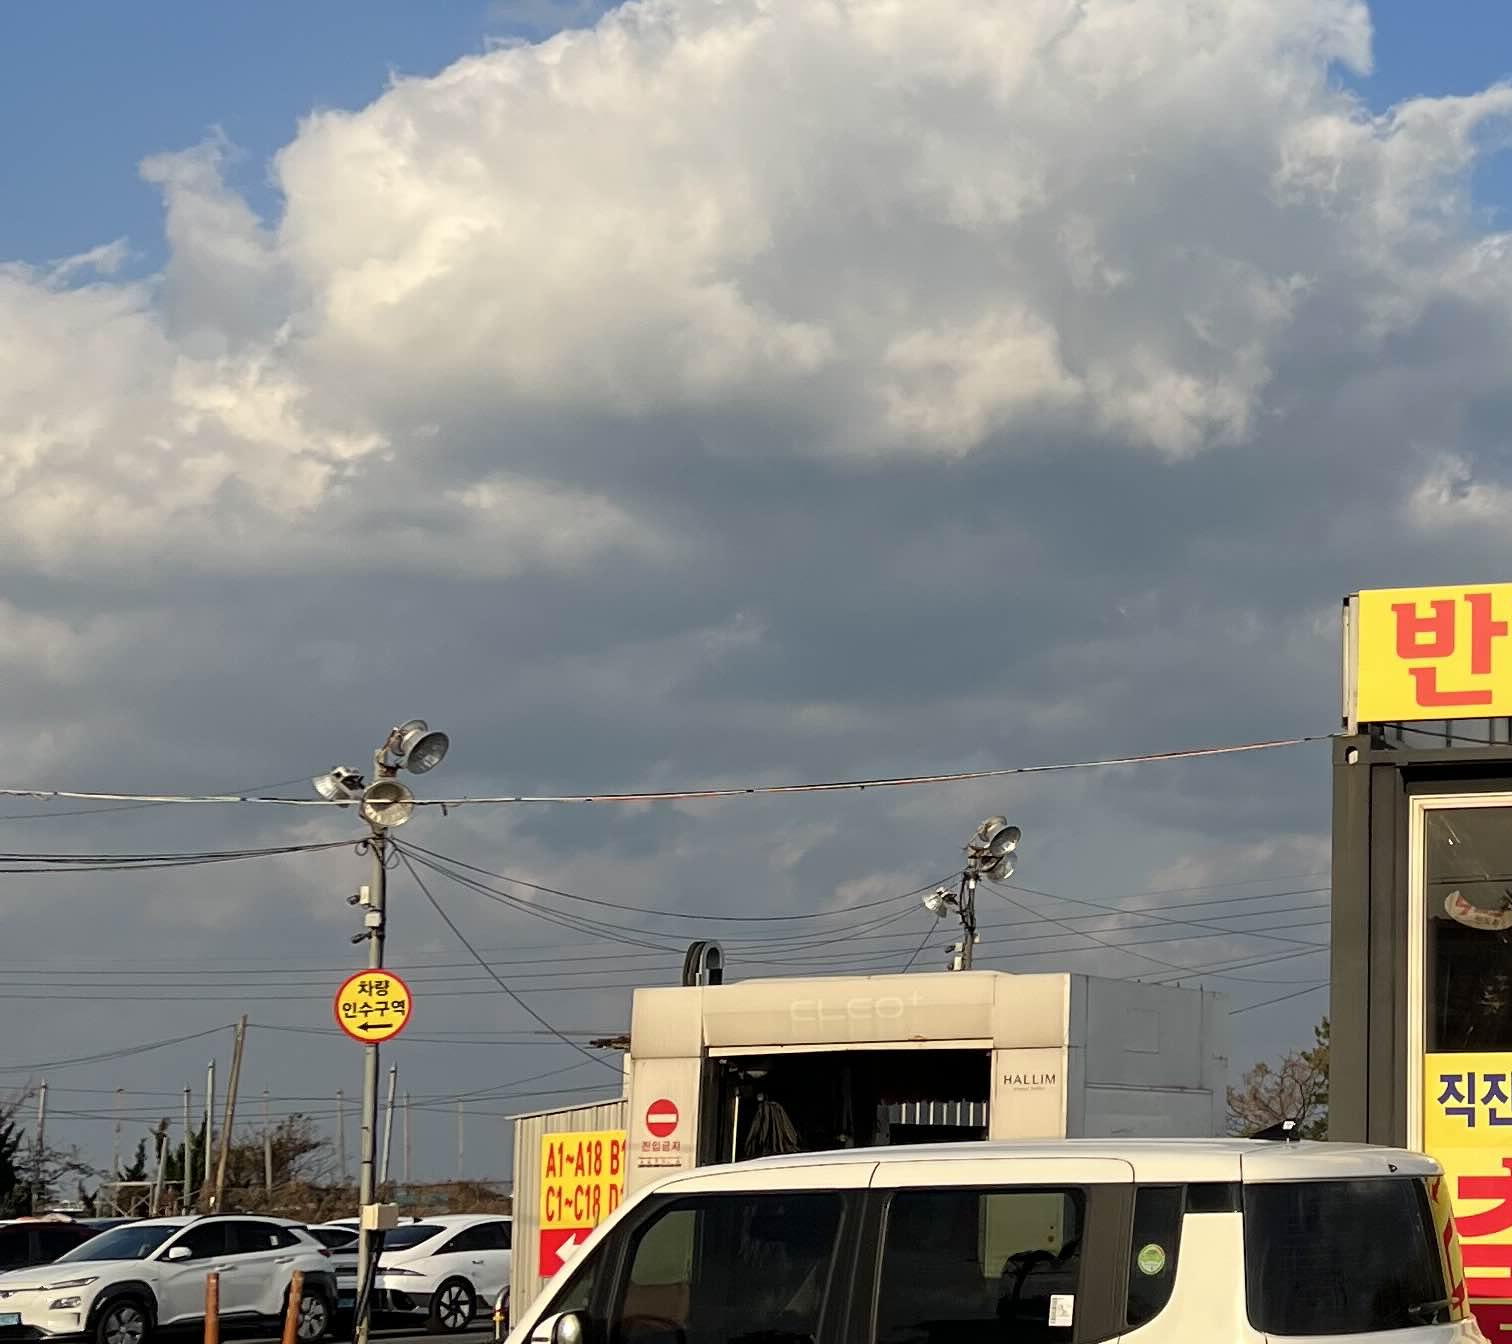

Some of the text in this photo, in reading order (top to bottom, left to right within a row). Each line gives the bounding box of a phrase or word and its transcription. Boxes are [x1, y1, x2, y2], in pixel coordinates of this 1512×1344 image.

[358, 979, 390, 997] 차량
[342, 999, 406, 1019] 인수구역
[1003, 1073, 1056, 1085] HALLIM
[641, 1141, 681, 1153] 진입금지
[545, 1140, 603, 1178] A1~A18
[545, 1183, 601, 1223] C1~C18
